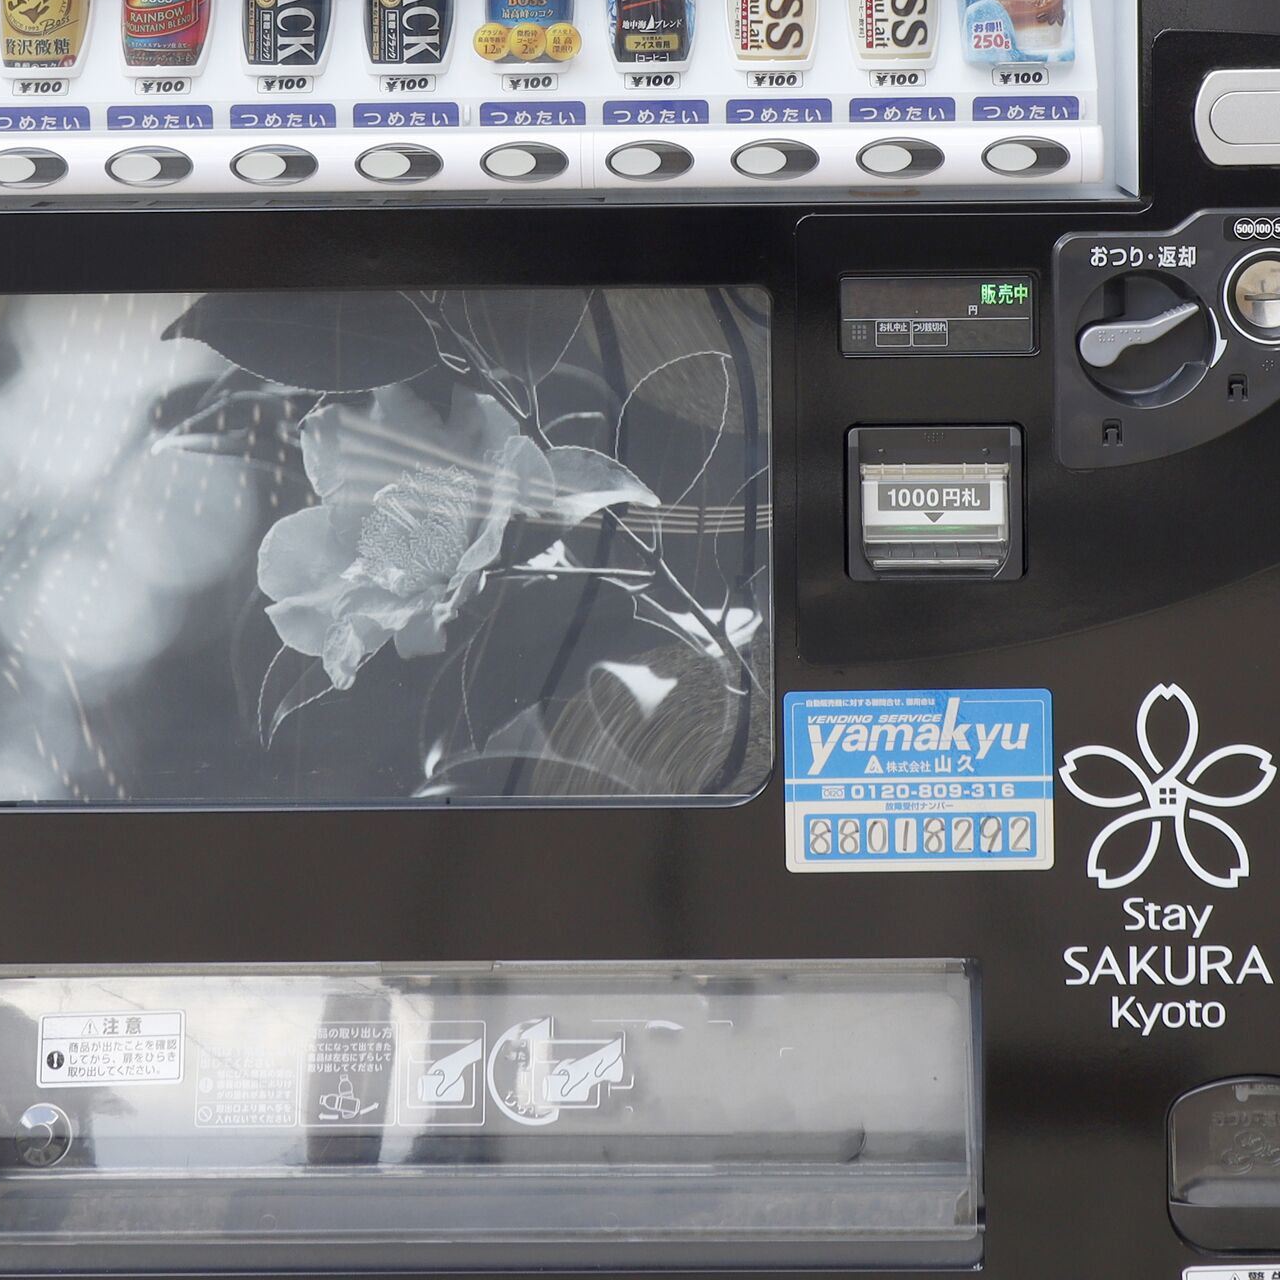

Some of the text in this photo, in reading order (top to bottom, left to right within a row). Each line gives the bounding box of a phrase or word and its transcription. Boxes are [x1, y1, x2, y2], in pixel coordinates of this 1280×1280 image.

[131, 6, 184, 23] RAINBOW
[501, 8, 554, 18] 最高峰のコク
[750, 21, 766, 50] Lait
[875, 20, 890, 48] Lait
[973, 34, 1011, 49] 250g
[6, 38, 70, 56] 贅沢微糖
[264, 78, 307, 90] ¥100
[385, 78, 429, 91] ¥100
[508, 76, 552, 89] ¥100
[631, 74, 675, 86] ¥100
[753, 73, 797, 86] ¥100
[876, 73, 919, 86] ¥100
[999, 72, 1043, 84] ¥100
[19, 81, 62, 93] ¥100
[142, 81, 185, 92] ¥100
[363, 111, 448, 127] つめたい
[490, 110, 576, 125] つめたい
[613, 109, 699, 124] つめたい
[736, 107, 822, 122] つめたい
[859, 106, 946, 121] つめたい
[982, 104, 1069, 119] つめたい
[117, 113, 205, 129] つめたい
[240, 112, 326, 128] つめたい
[1237, 224, 1253, 233] 500
[1256, 224, 1270, 233] 100
[1090, 246, 1197, 267] おつり・返却
[981, 284, 1028, 304] 販売中
[968, 305, 978, 315] 円
[879, 323, 908, 332] お札中止
[888, 488, 980, 506] 1000円札
[807, 714, 942, 723] VENDING SERVICE
[807, 697, 1029, 775] yamakyu
[886, 760, 931, 772] 株式会社
[851, 784, 1014, 799] 0120-809-316
[885, 802, 953, 810] 故障受付ナンバー
[1123, 897, 1213, 938] Stay
[1064, 945, 1274, 985] SAKURA
[1112, 996, 1226, 1036] Kyoto
